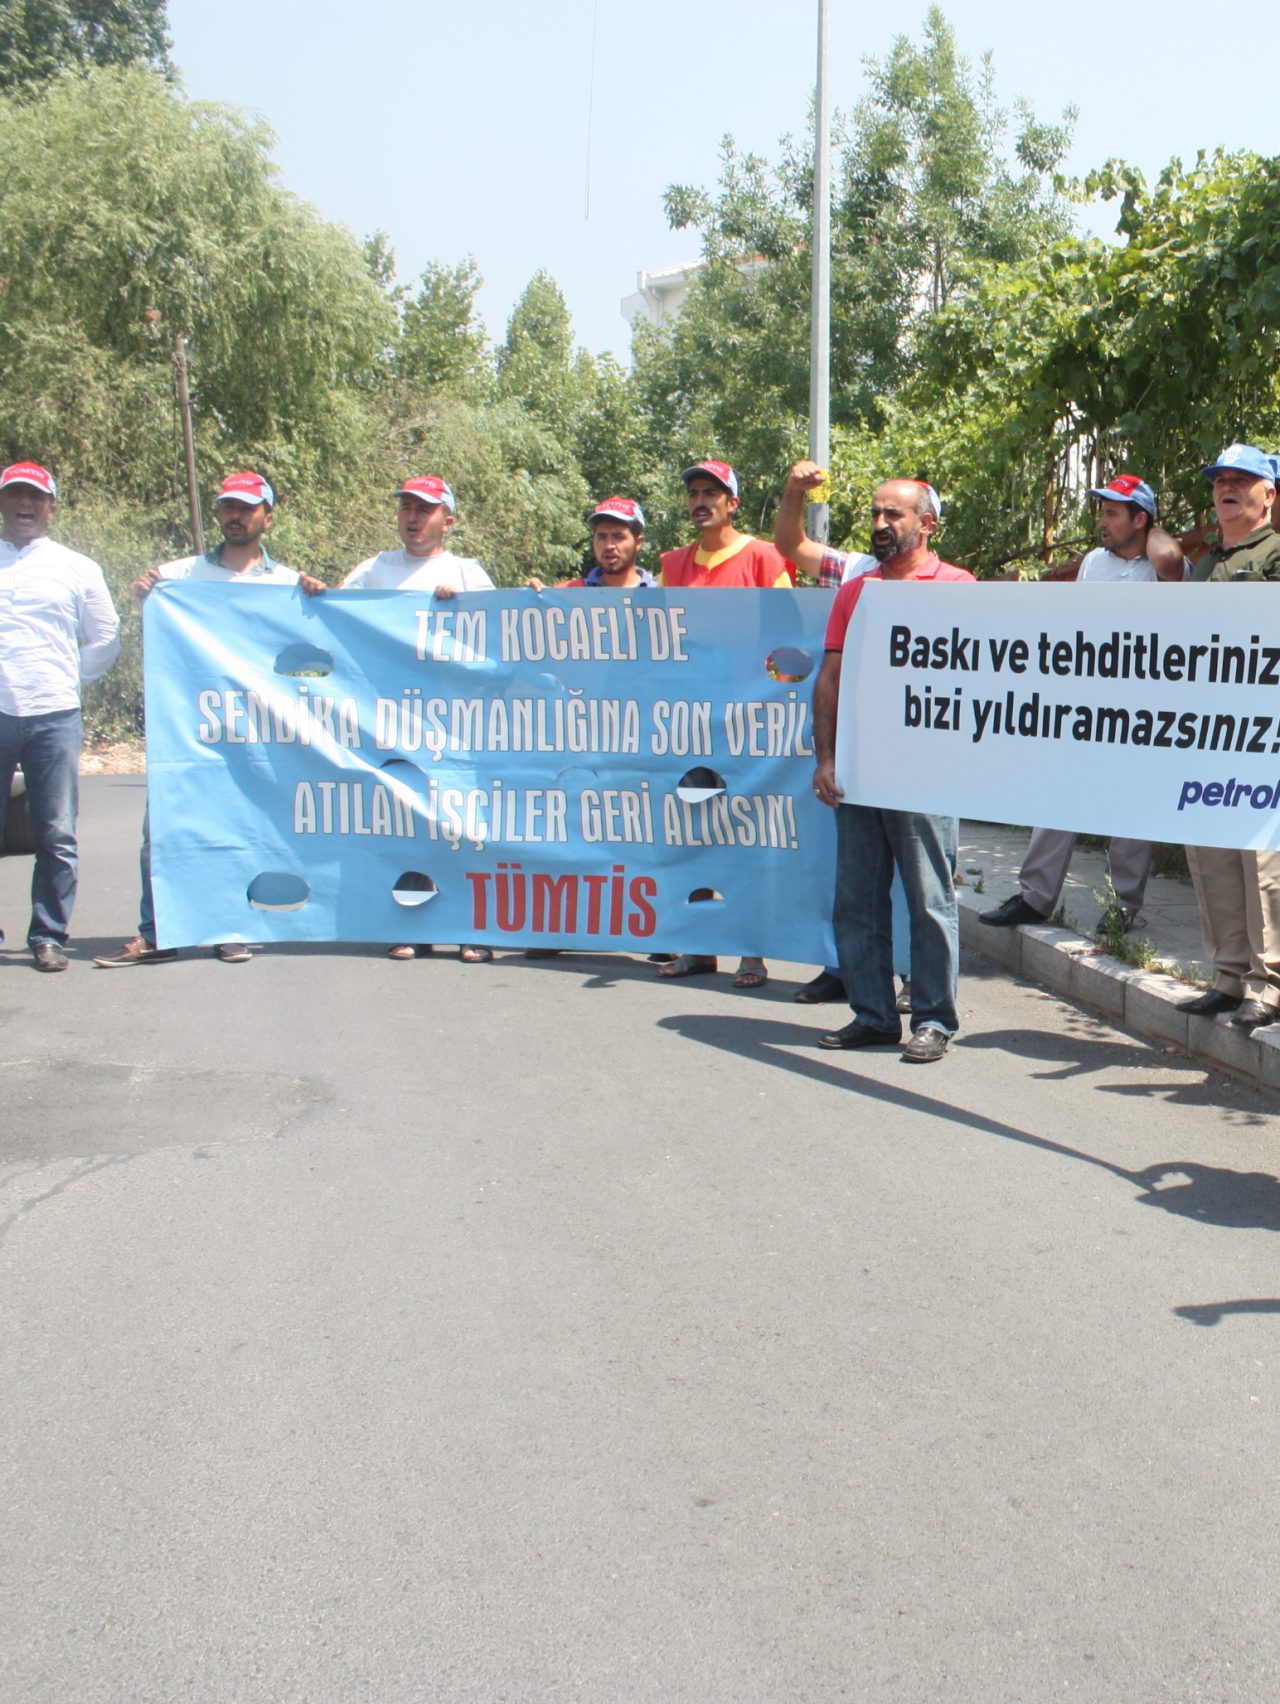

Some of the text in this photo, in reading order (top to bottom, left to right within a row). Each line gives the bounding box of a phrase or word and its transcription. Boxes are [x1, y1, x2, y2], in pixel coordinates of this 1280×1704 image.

[414, 597, 689, 663] TEM KOCAELİ'DE
[889, 625, 980, 672] Baskı
[990, 637, 1030, 674] ve
[198, 685, 816, 762] SENDİKA DÜŞMANLIĞINA SON VERİL
[904, 685, 962, 731] bizi
[294, 779, 799, 852] ATILAN İŞÇİLER GERİ ALINSIN!
[465, 862, 658, 938] TÜMTİS
